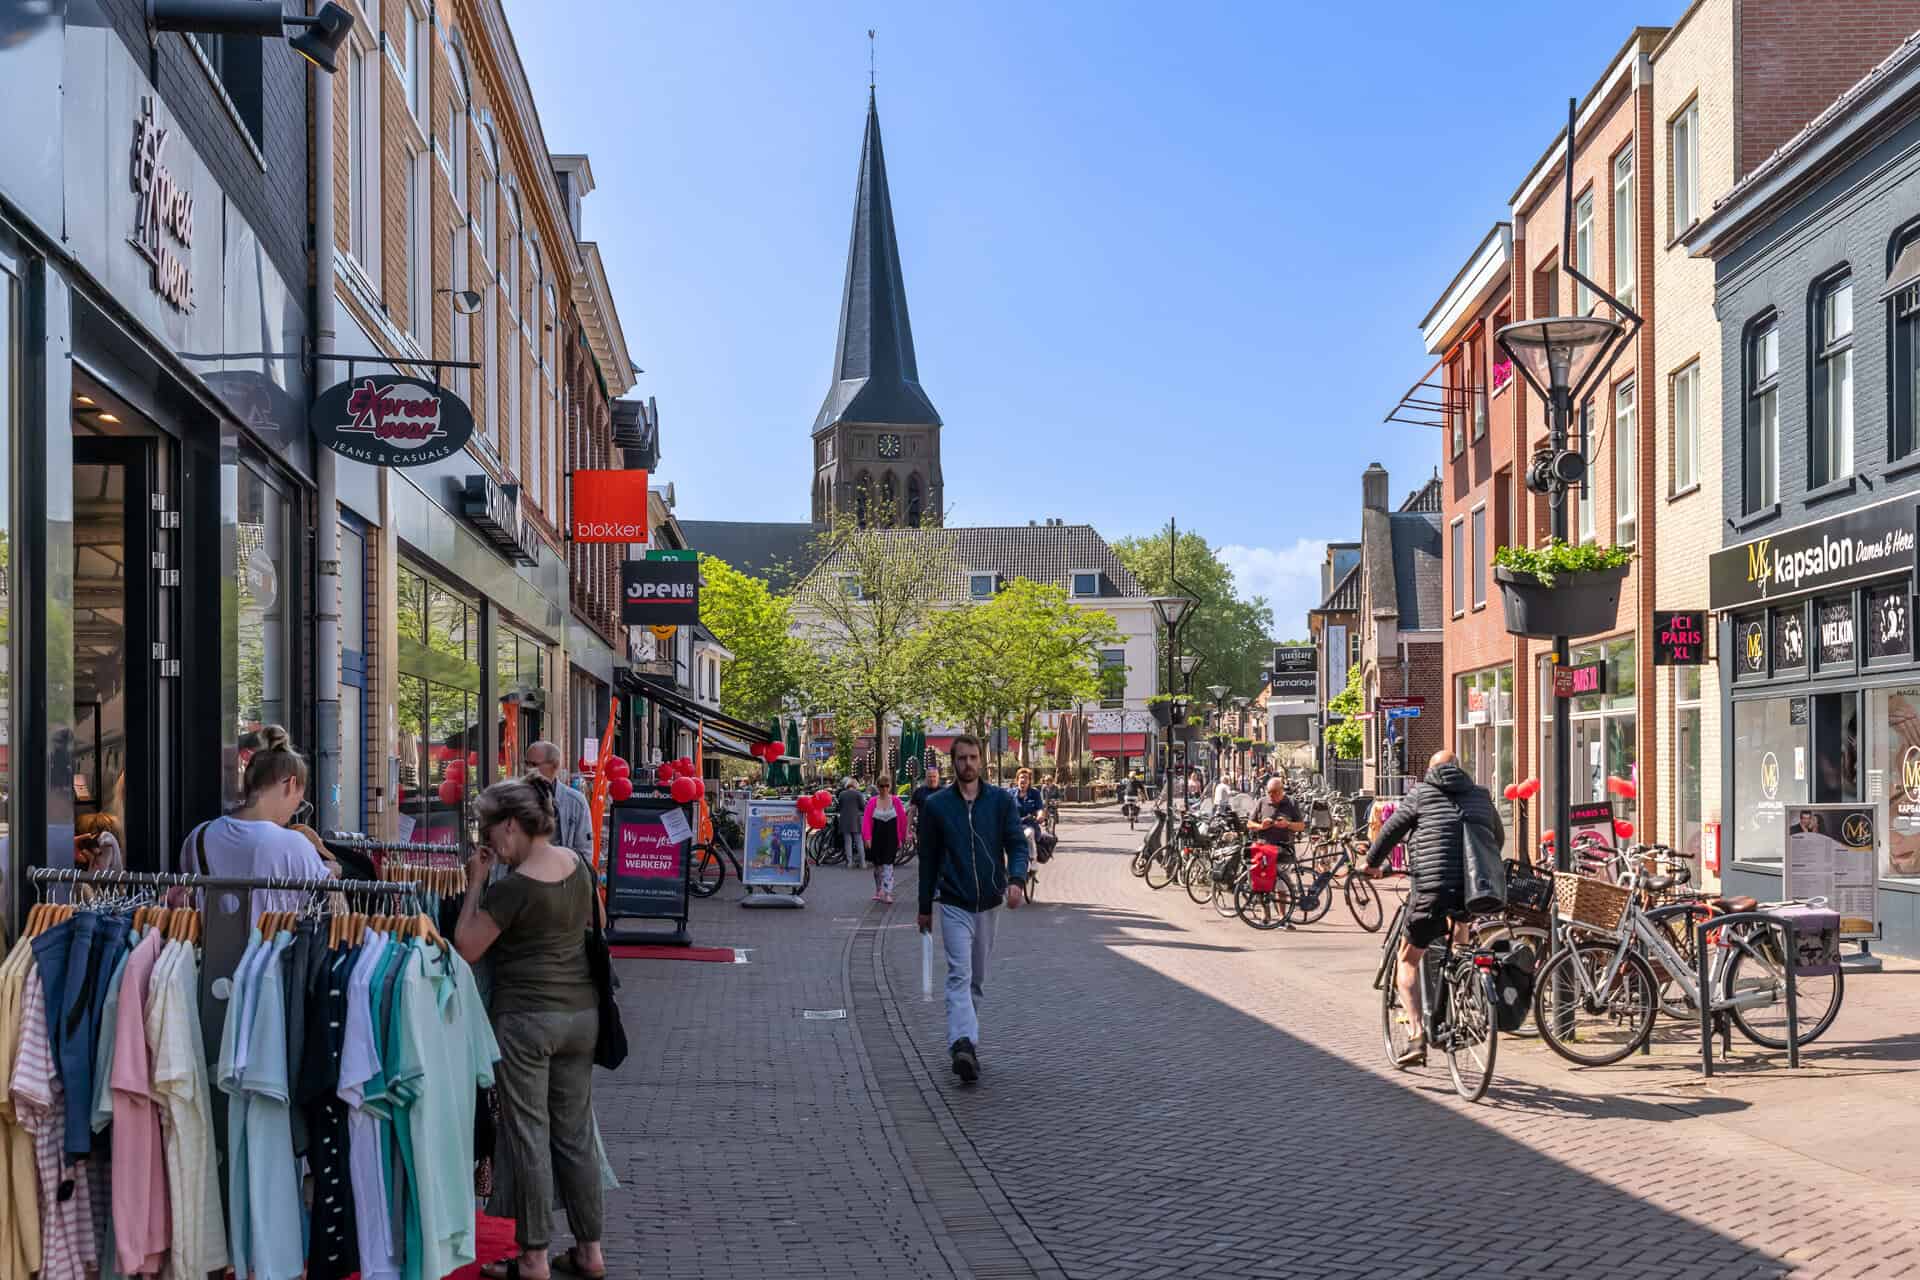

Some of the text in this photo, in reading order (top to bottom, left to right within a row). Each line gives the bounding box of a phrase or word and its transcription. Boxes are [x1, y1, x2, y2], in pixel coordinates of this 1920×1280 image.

[332, 440, 449, 463] JEANS & CASUALS
[1775, 535, 1853, 587] kapsalon
[1856, 541, 1883, 563] Dames
[1885, 532, 1893, 557] &
[626, 583, 685, 598] OPEN
[1671, 616, 1691, 629] ICI
[1661, 631, 1701, 645] PARIS
[1673, 646, 1690, 659] XL
[782, 829, 800, 838] 40%
[625, 859, 673, 870] WERKEN?
